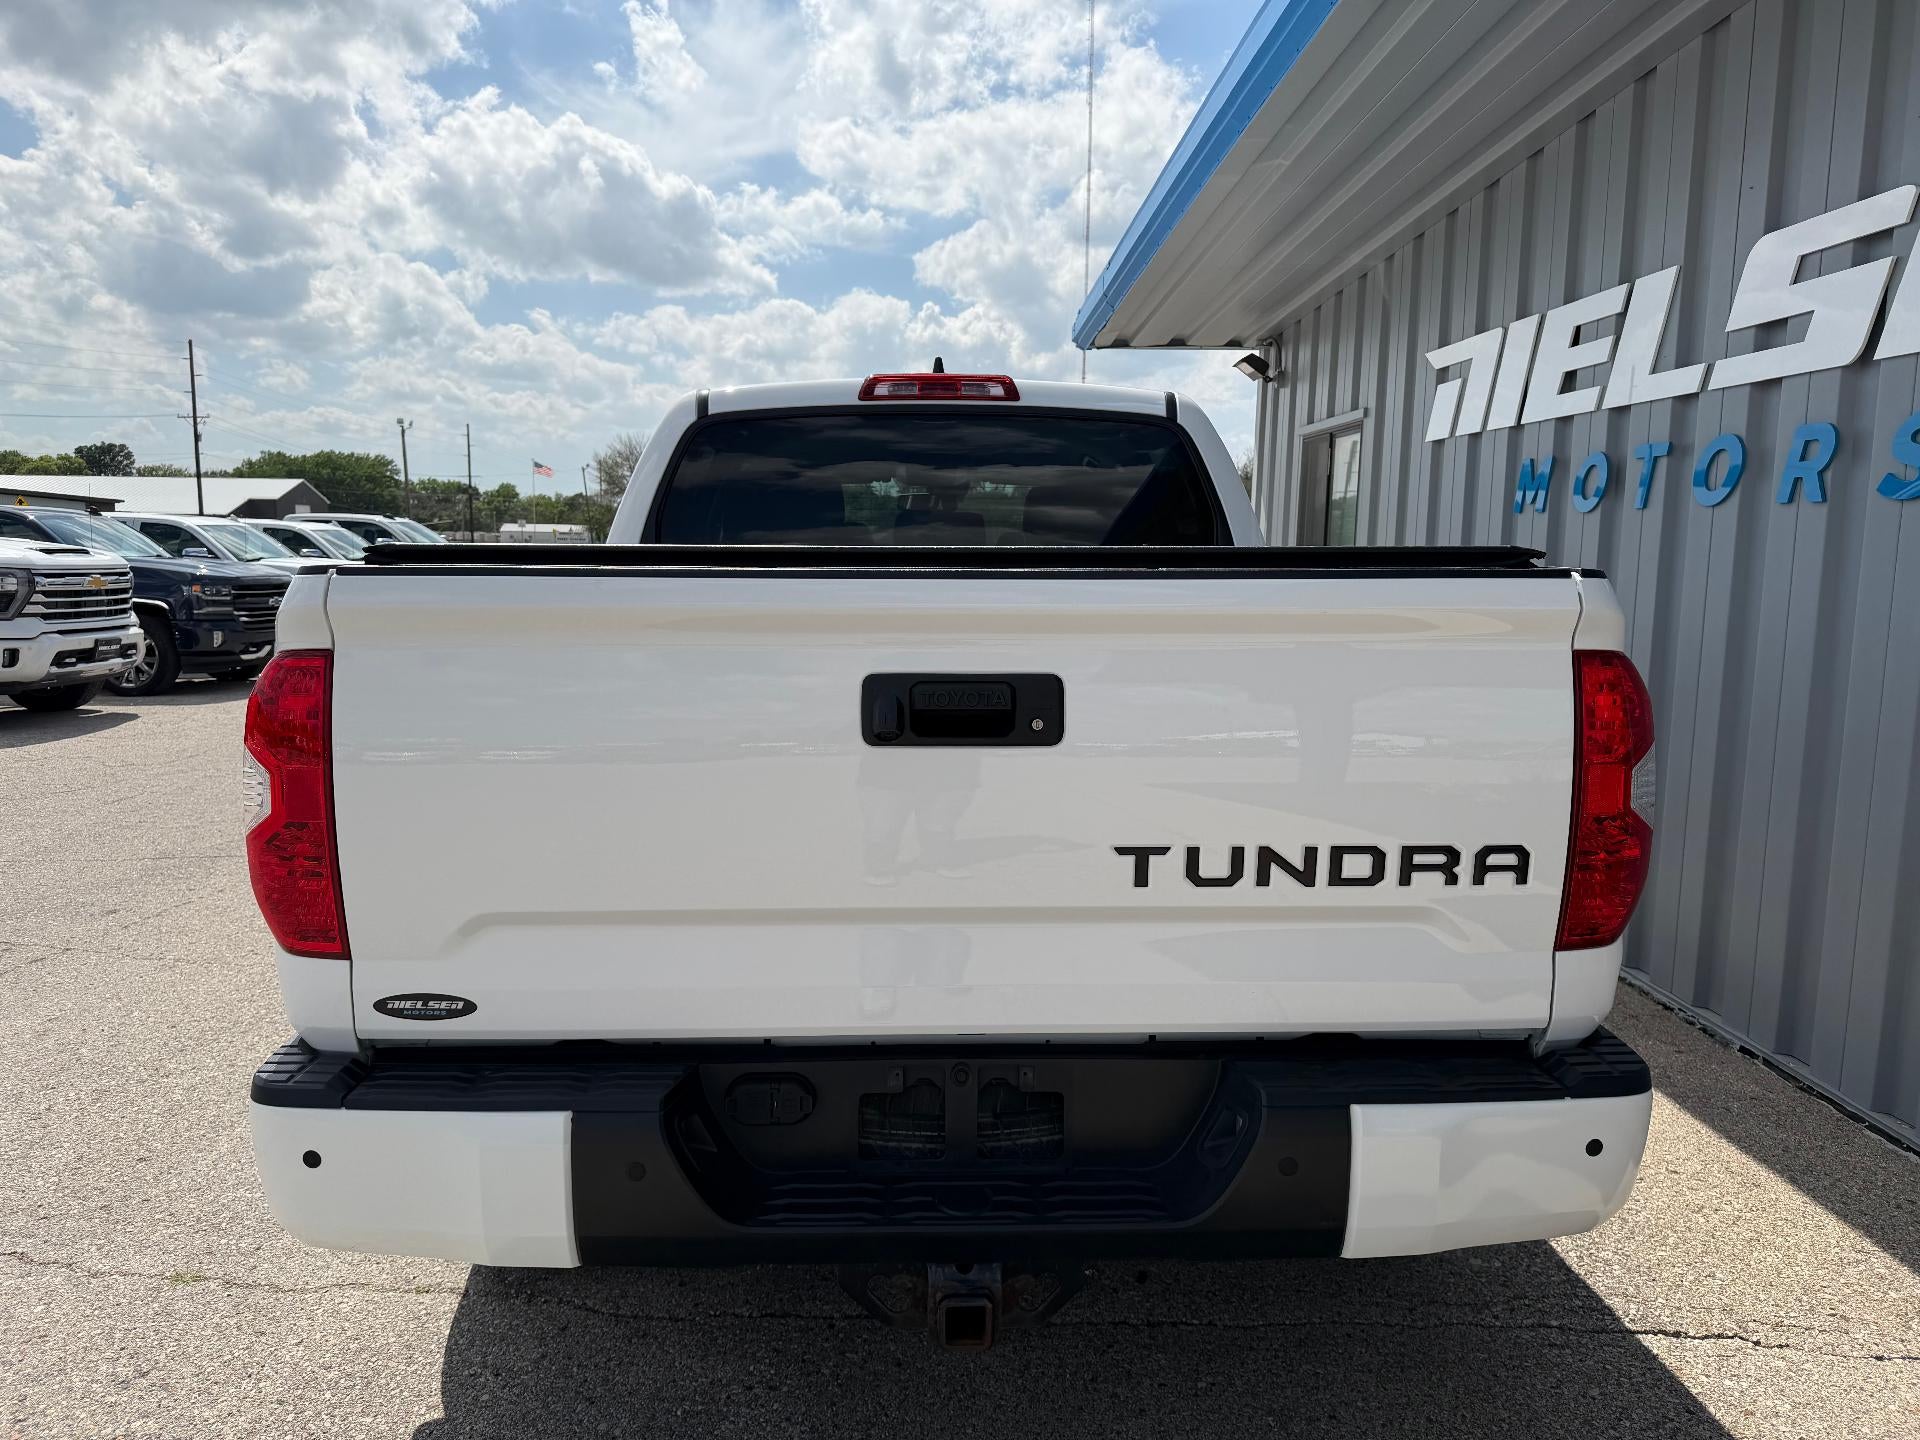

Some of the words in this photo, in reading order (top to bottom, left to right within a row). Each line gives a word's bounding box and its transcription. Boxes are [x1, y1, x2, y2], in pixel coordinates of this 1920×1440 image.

[1426, 184, 1920, 442] NIELS
[920, 688, 1008, 707] TOYOTA
[1112, 844, 1532, 888] TUNDRA
[385, 1000, 465, 1010] NIELSEN
